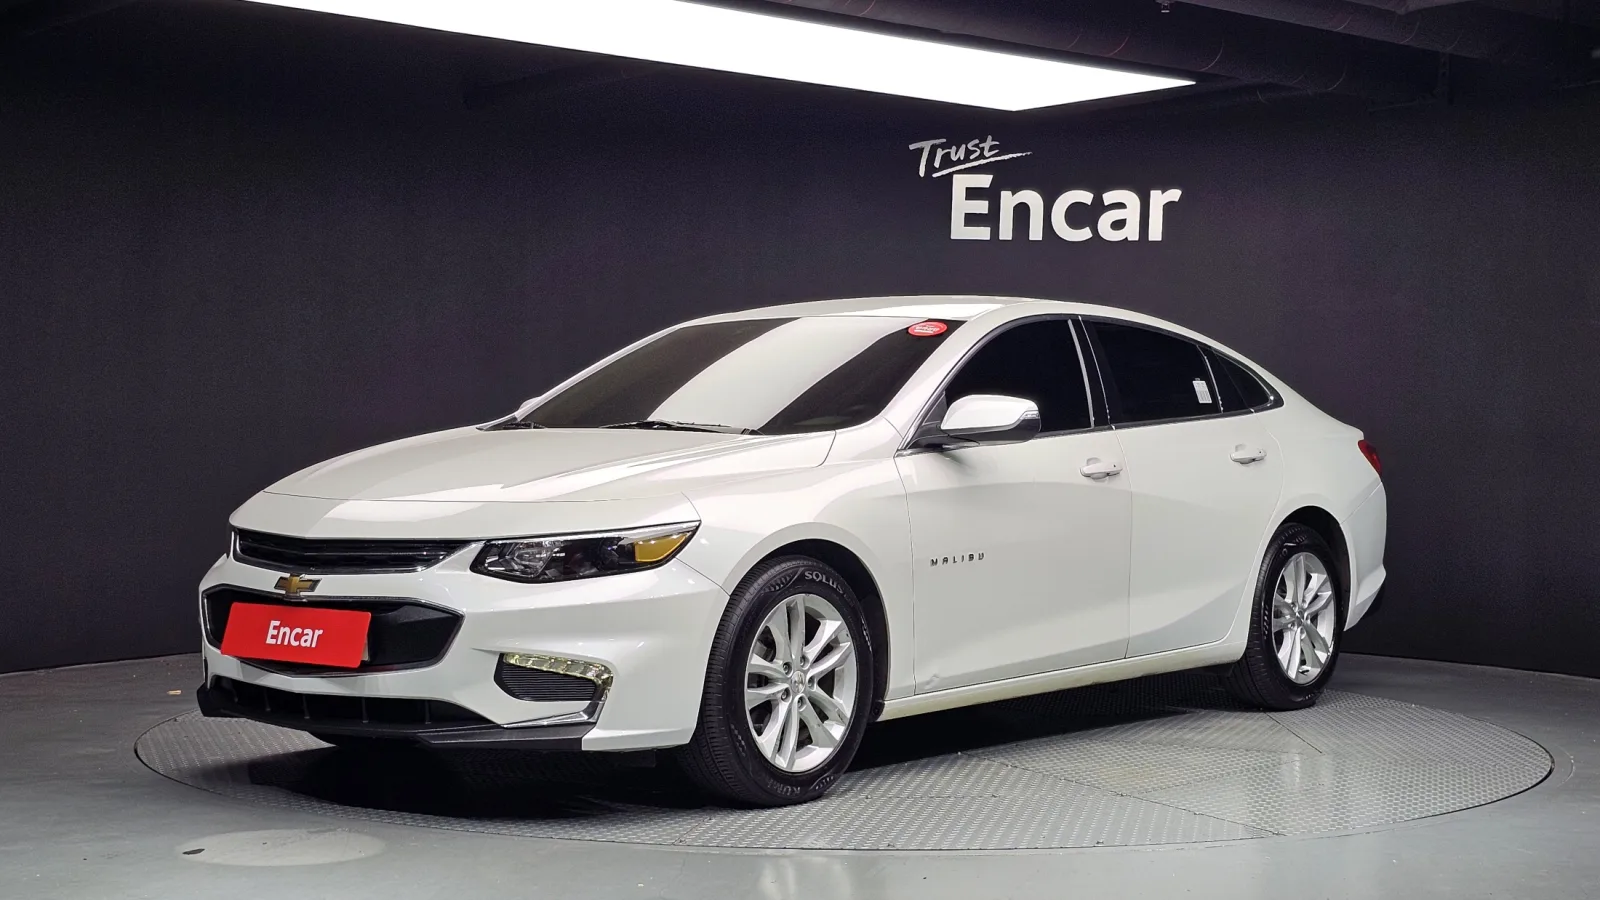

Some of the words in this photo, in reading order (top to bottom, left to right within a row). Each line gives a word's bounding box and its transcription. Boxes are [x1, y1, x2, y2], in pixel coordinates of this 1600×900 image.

[908, 135, 1005, 178] Trust
[950, 174, 1182, 242] Encar
[930, 552, 985, 567] MALIBU
[804, 570, 843, 594] SOLUS
[265, 620, 324, 648] Encar
